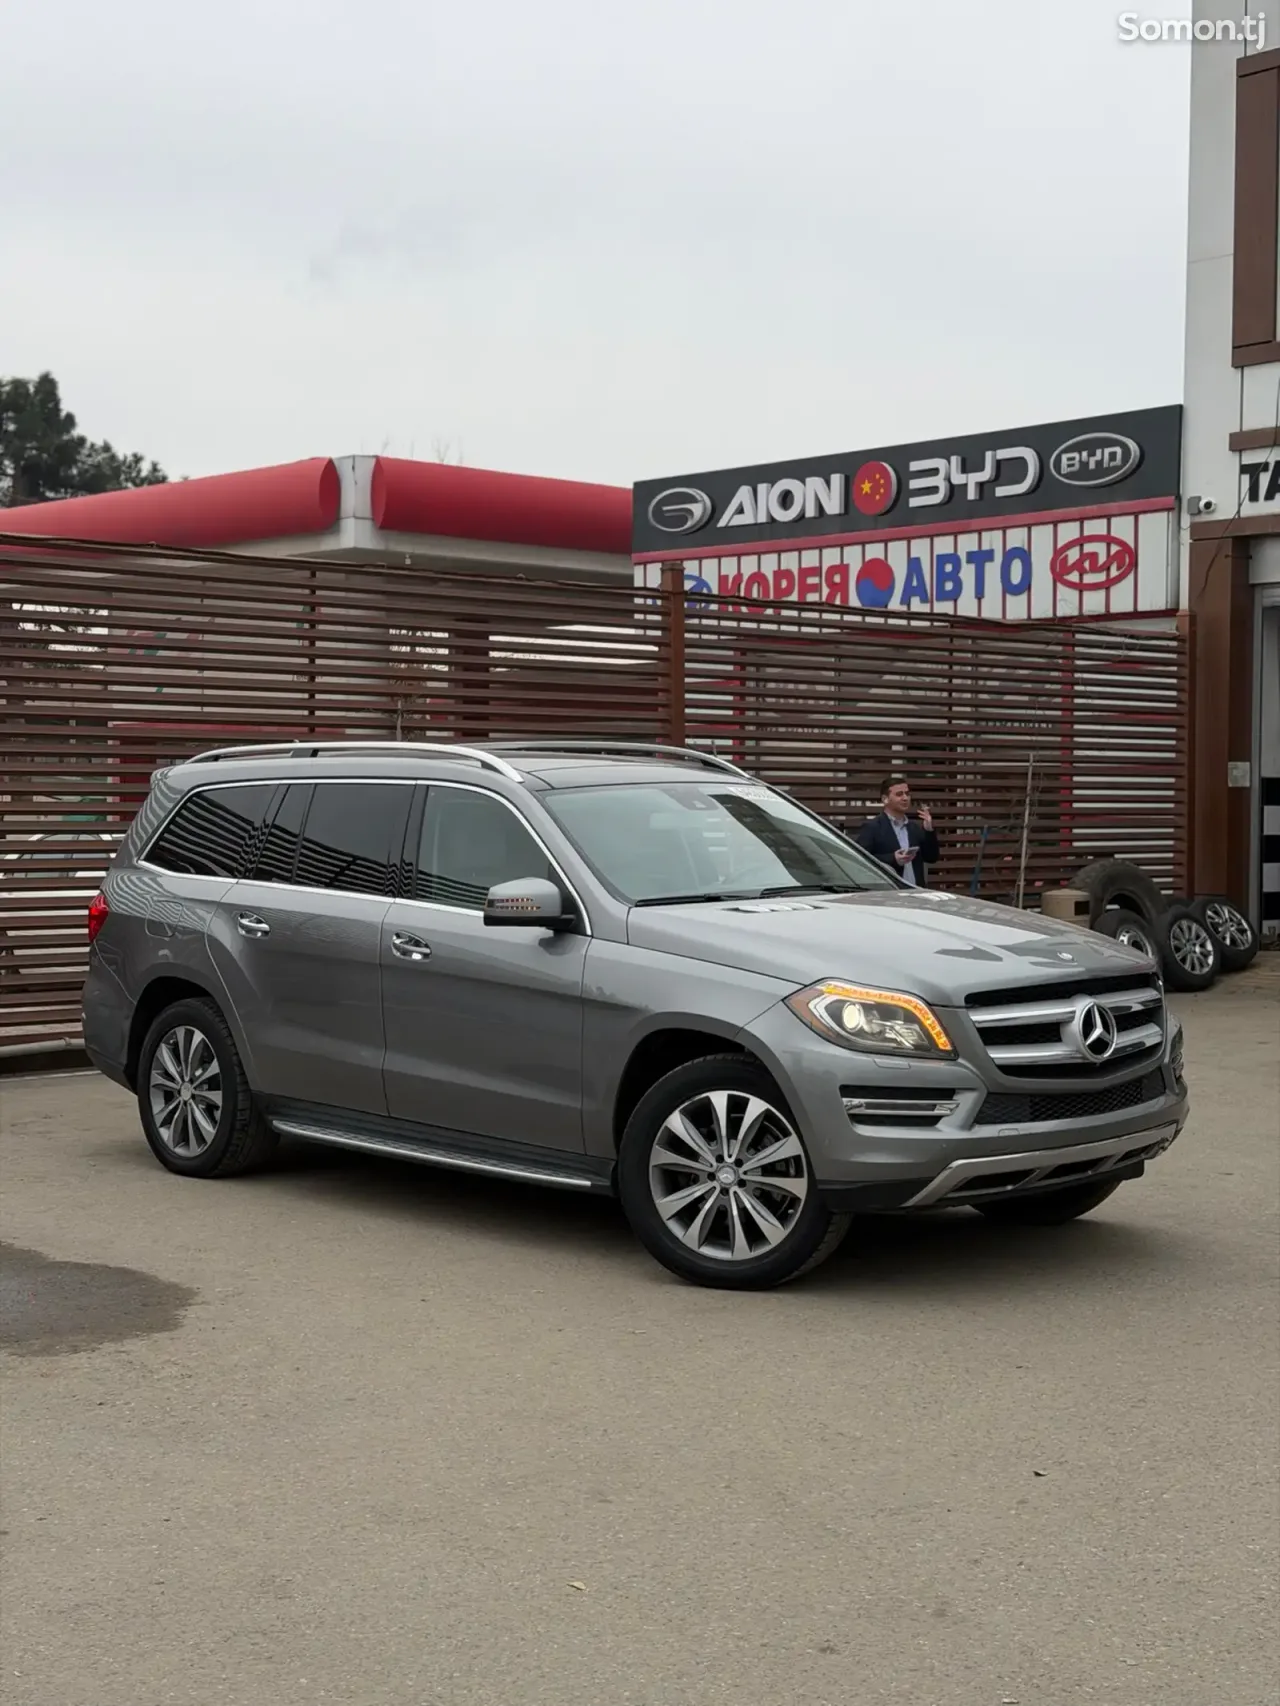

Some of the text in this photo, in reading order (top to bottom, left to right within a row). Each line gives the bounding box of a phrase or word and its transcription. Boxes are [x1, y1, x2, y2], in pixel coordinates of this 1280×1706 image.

[716, 446, 1040, 527] AION BYD
[1060, 446, 1123, 474] BYD
[718, 547, 1032, 614] КОРЕЯ АВТО
